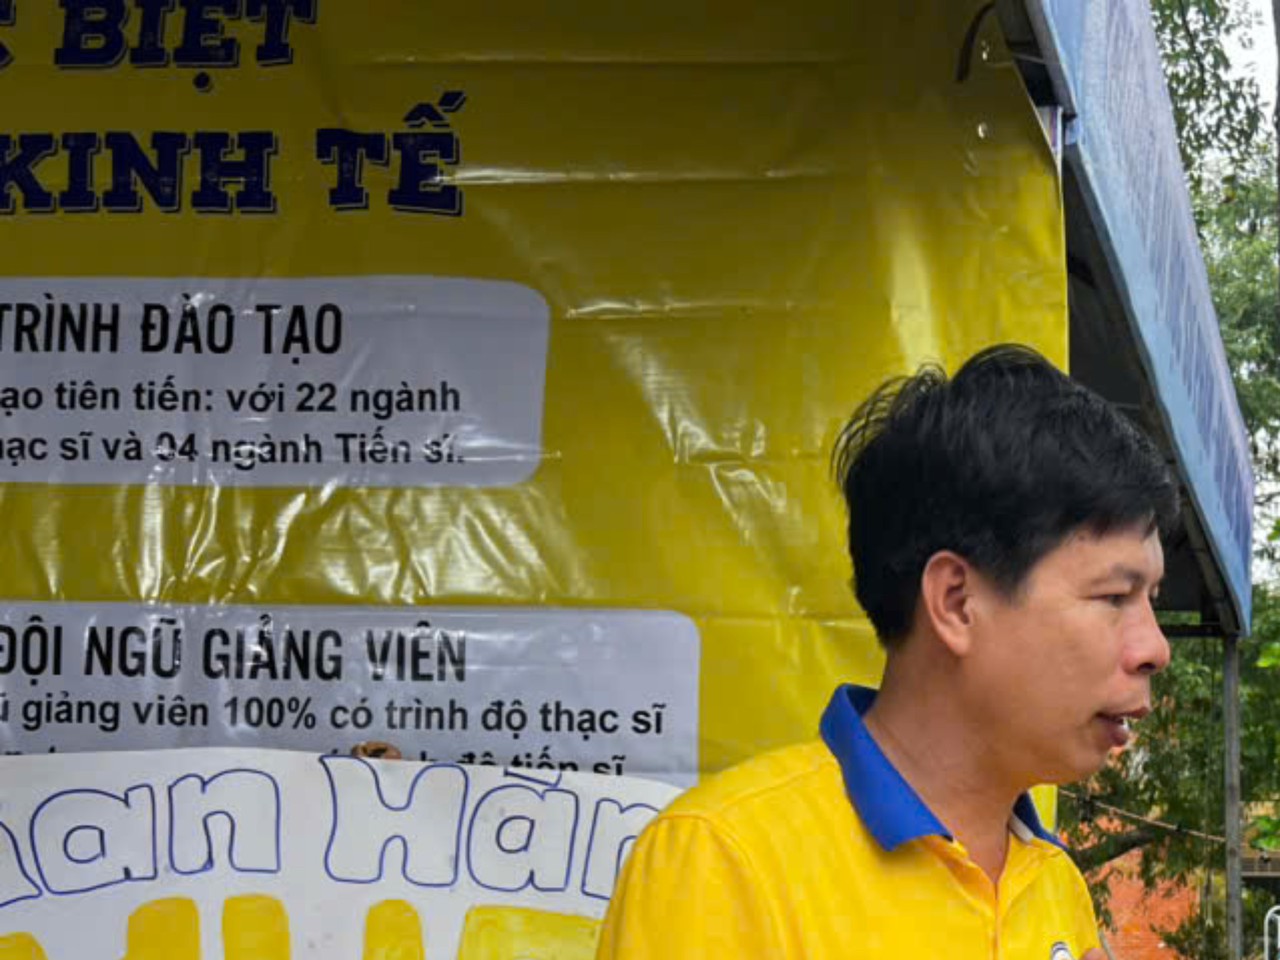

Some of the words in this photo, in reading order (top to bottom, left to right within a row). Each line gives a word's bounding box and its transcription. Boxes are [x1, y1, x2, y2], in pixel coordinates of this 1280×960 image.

[0, 130, 279, 214] KINH
[316, 91, 467, 216] TẾ
[0, 293, 119, 352] TRÌNH
[141, 293, 234, 354] ĐÀO
[256, 303, 342, 365] TẠO
[0, 387, 43, 417] ạo
[55, 380, 119, 411] tiên
[133, 375, 213, 412] tiến:
[226, 383, 284, 412] với
[296, 382, 336, 412] 22
[350, 381, 460, 420] ngành
[0, 437, 47, 467] ạc
[59, 431, 93, 460] sĩ
[102, 430, 142, 460] và
[156, 432, 198, 461] 04
[212, 433, 322, 471] ngành
[335, 426, 410, 463] Tiến
[0, 615, 62, 686] ĐỘI
[84, 618, 182, 678] NGŨ
[202, 614, 342, 681] GIẢNG
[366, 620, 466, 682] VIÊN
[22, 691, 120, 732] giảng
[133, 696, 208, 727] viên
[223, 697, 316, 730] 100%
[329, 698, 373, 729] có
[385, 700, 468, 731] trình
[481, 701, 527, 739] độ
[540, 702, 619, 741] thạc
[631, 704, 667, 734] sĩ
